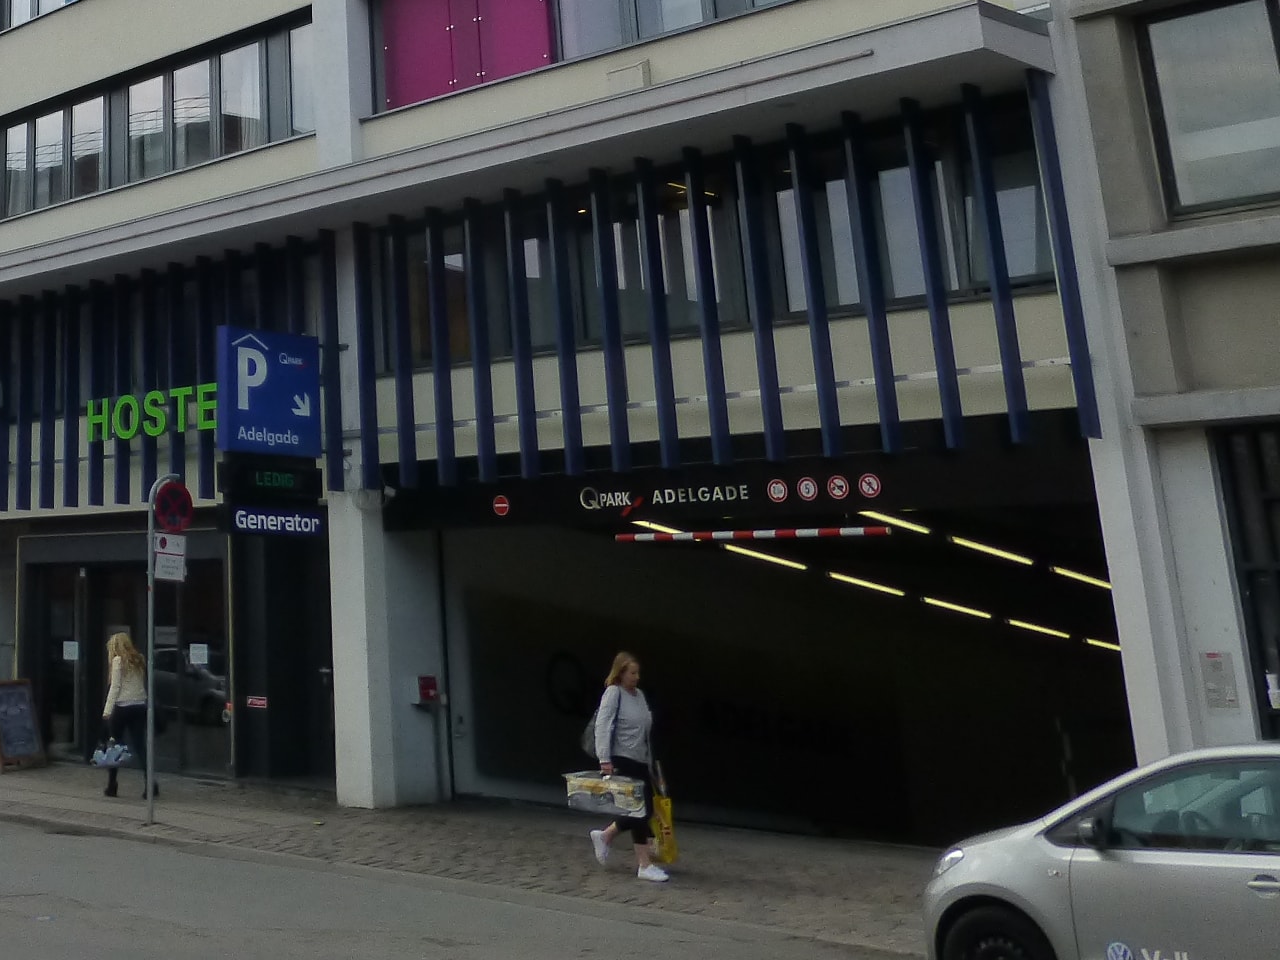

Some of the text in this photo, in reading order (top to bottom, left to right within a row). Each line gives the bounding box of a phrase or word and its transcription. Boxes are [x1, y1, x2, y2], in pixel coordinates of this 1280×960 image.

[237, 346, 268, 411] P
[86, 382, 217, 443] HOSTE
[237, 425, 300, 447] Adelgade
[255, 470, 295, 488] LEDIG
[652, 484, 750, 505] ADELGADE
[235, 509, 320, 534] Generator
